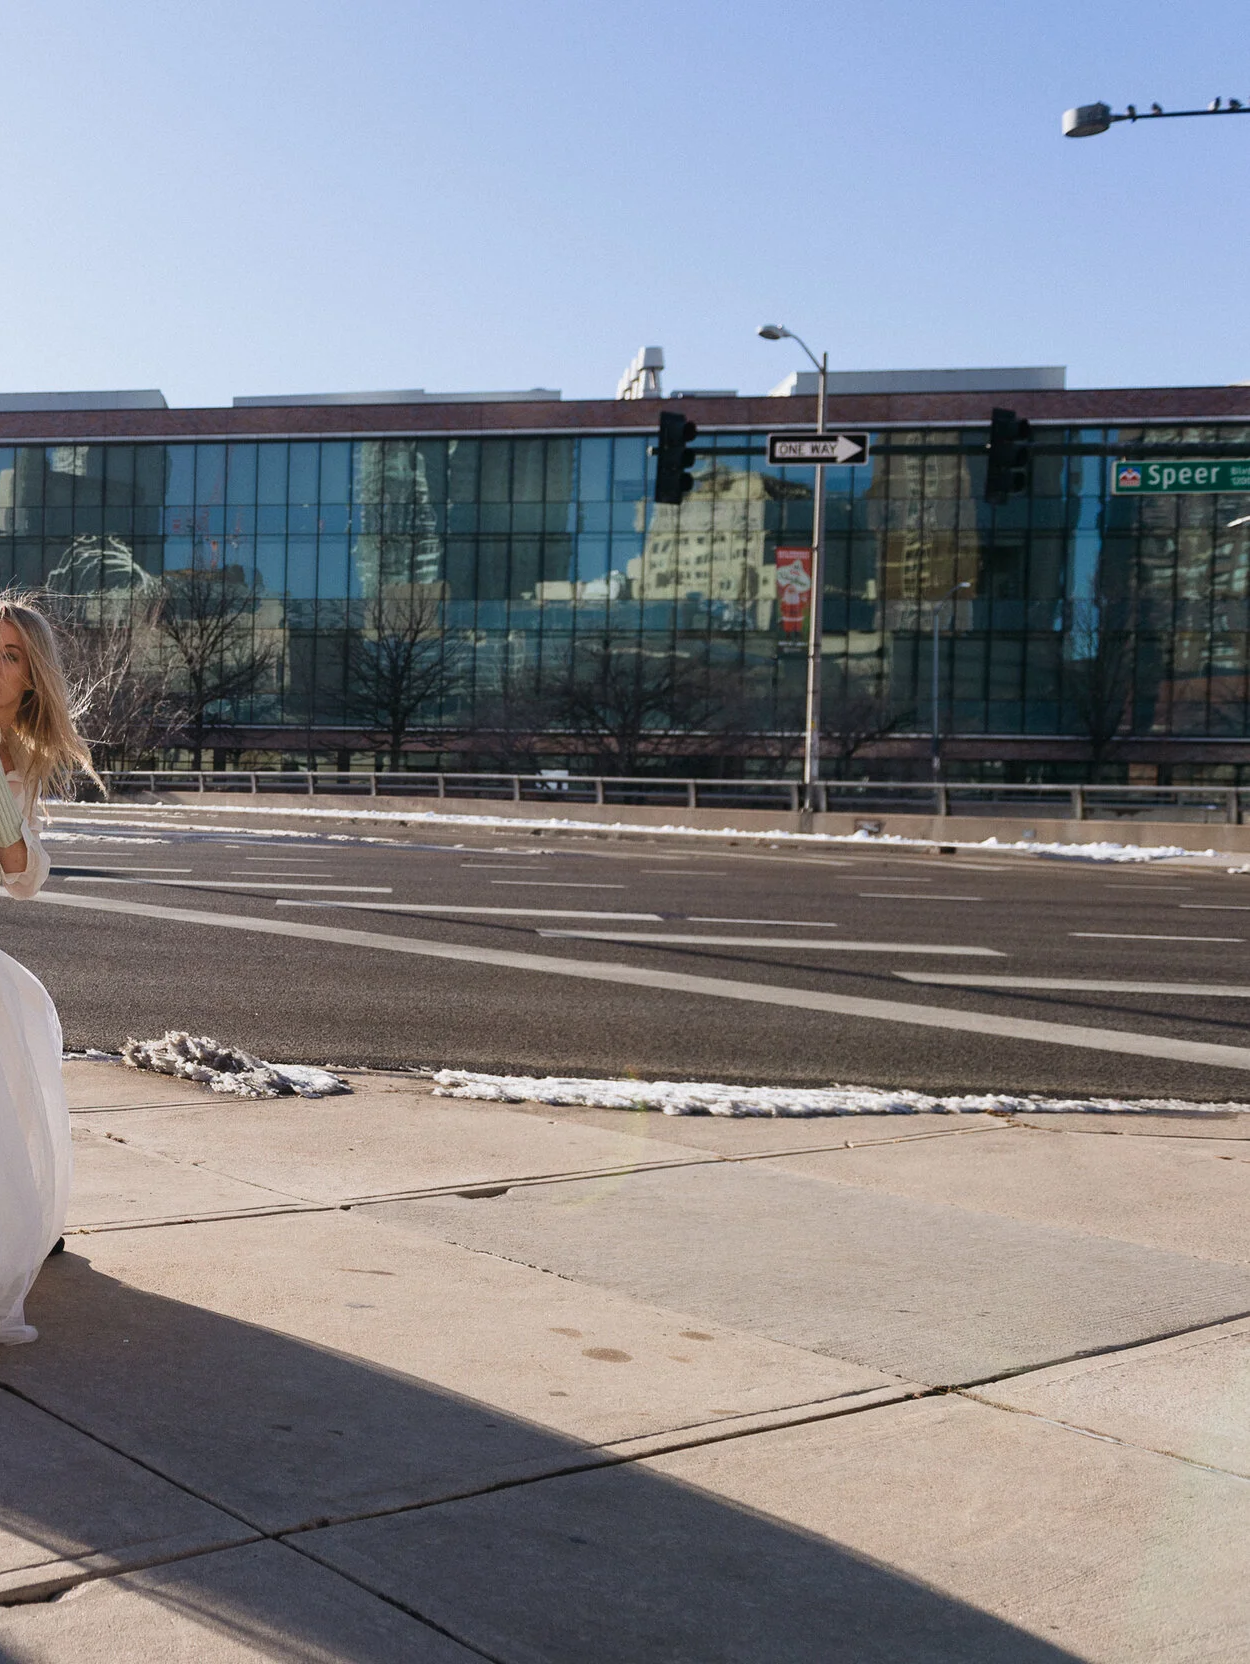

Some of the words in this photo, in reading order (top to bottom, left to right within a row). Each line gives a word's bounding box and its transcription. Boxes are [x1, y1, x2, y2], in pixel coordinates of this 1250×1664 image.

[779, 443, 807, 455] ONE
[811, 444, 838, 455] WAY
[1148, 464, 1220, 490] Speer
